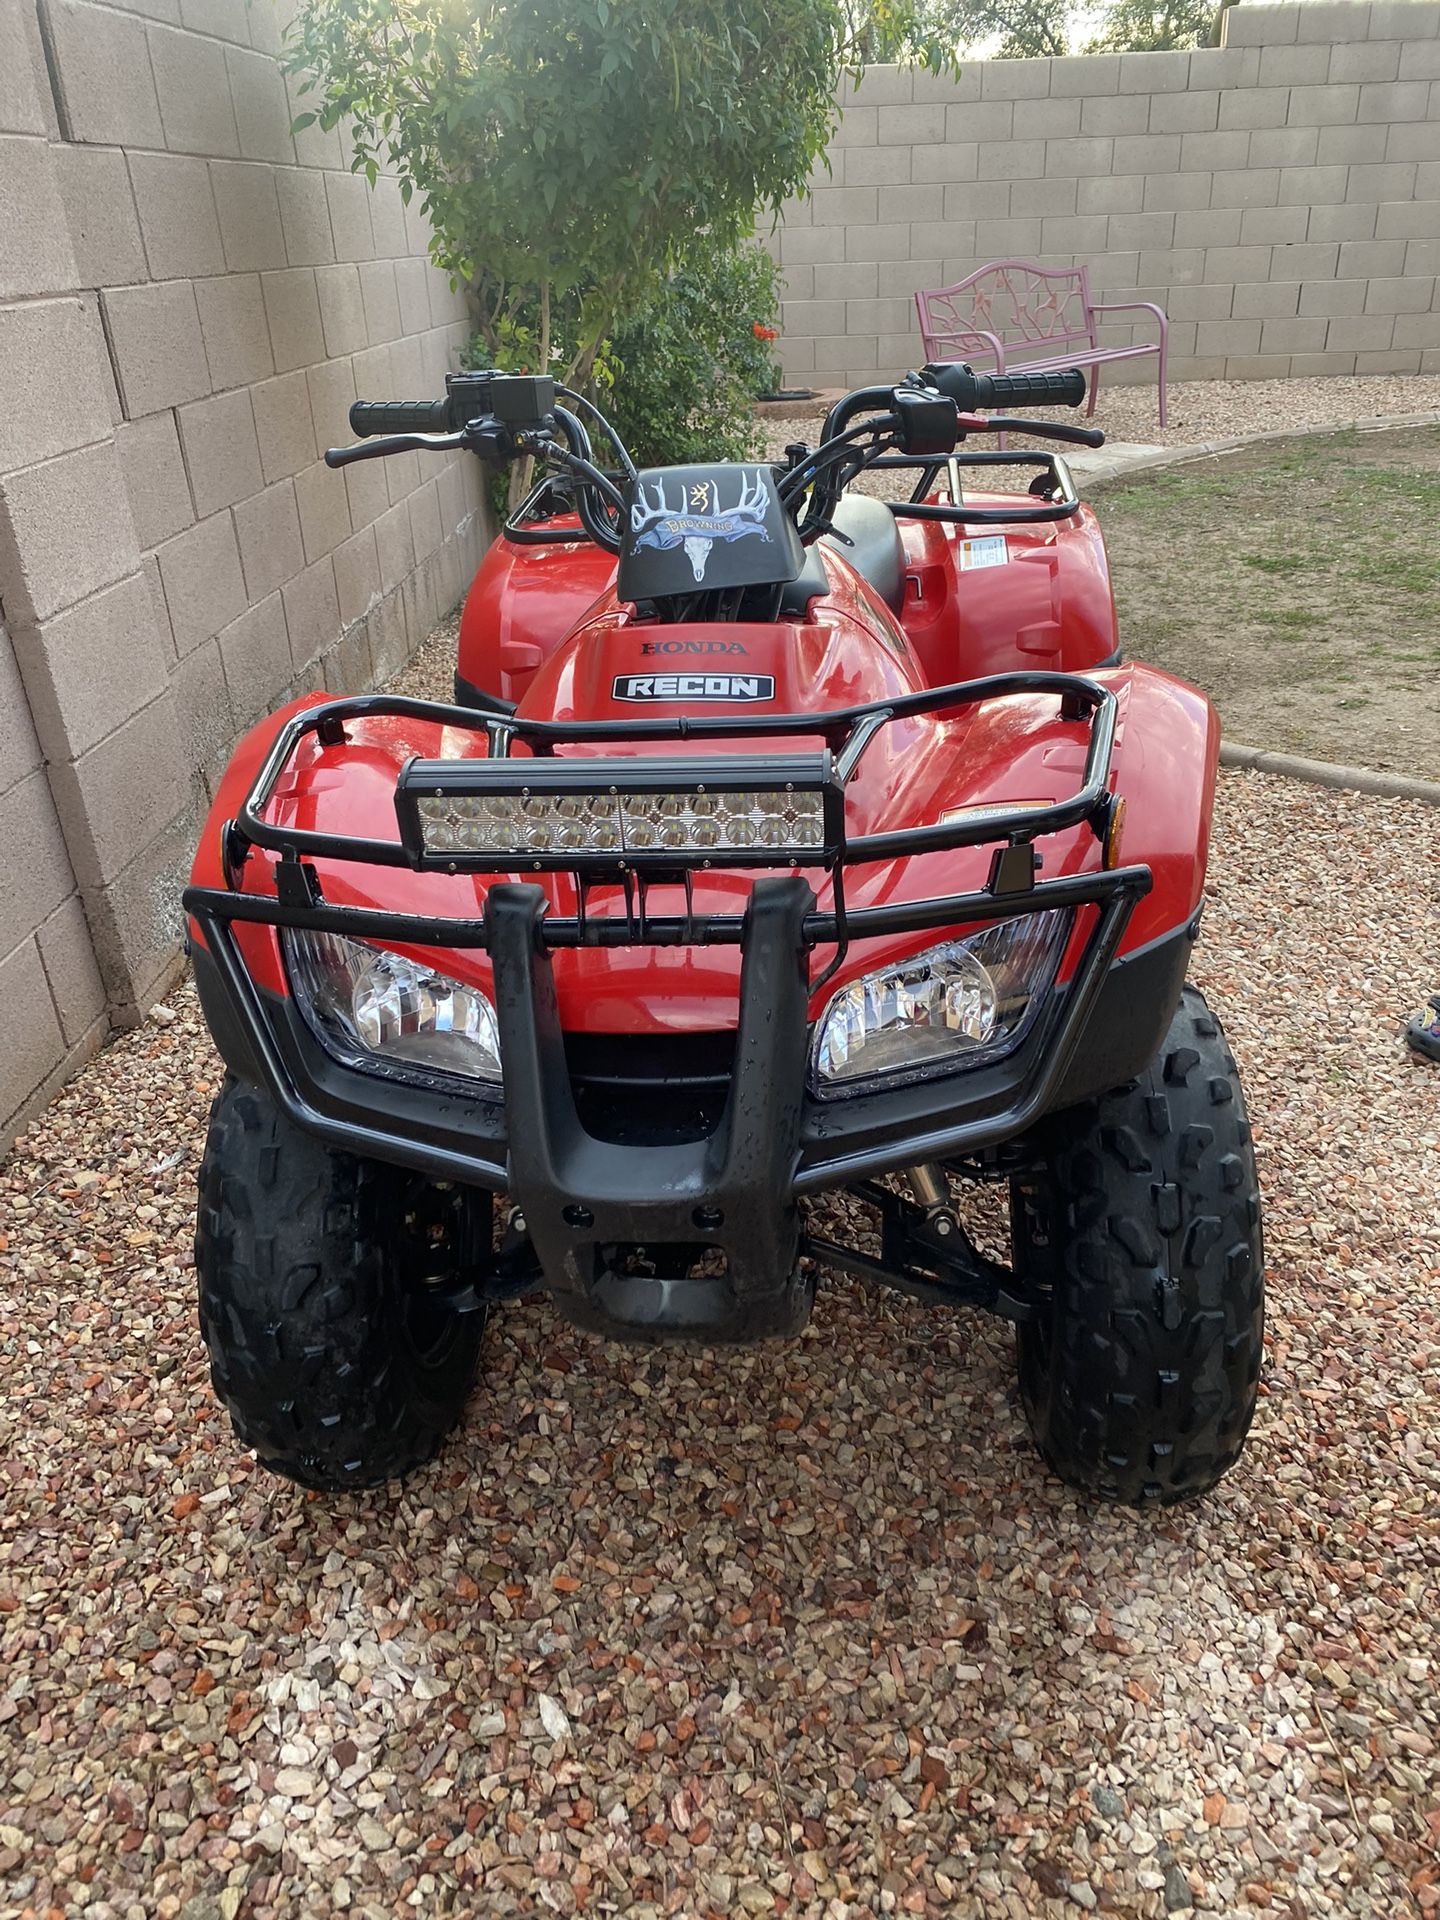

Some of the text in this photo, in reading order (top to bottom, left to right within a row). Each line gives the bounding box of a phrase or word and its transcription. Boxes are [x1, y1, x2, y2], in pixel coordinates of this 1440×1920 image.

[665, 519, 733, 534] BROWNING
[642, 642, 747, 655] HONDA
[627, 677, 758, 697] RECON
